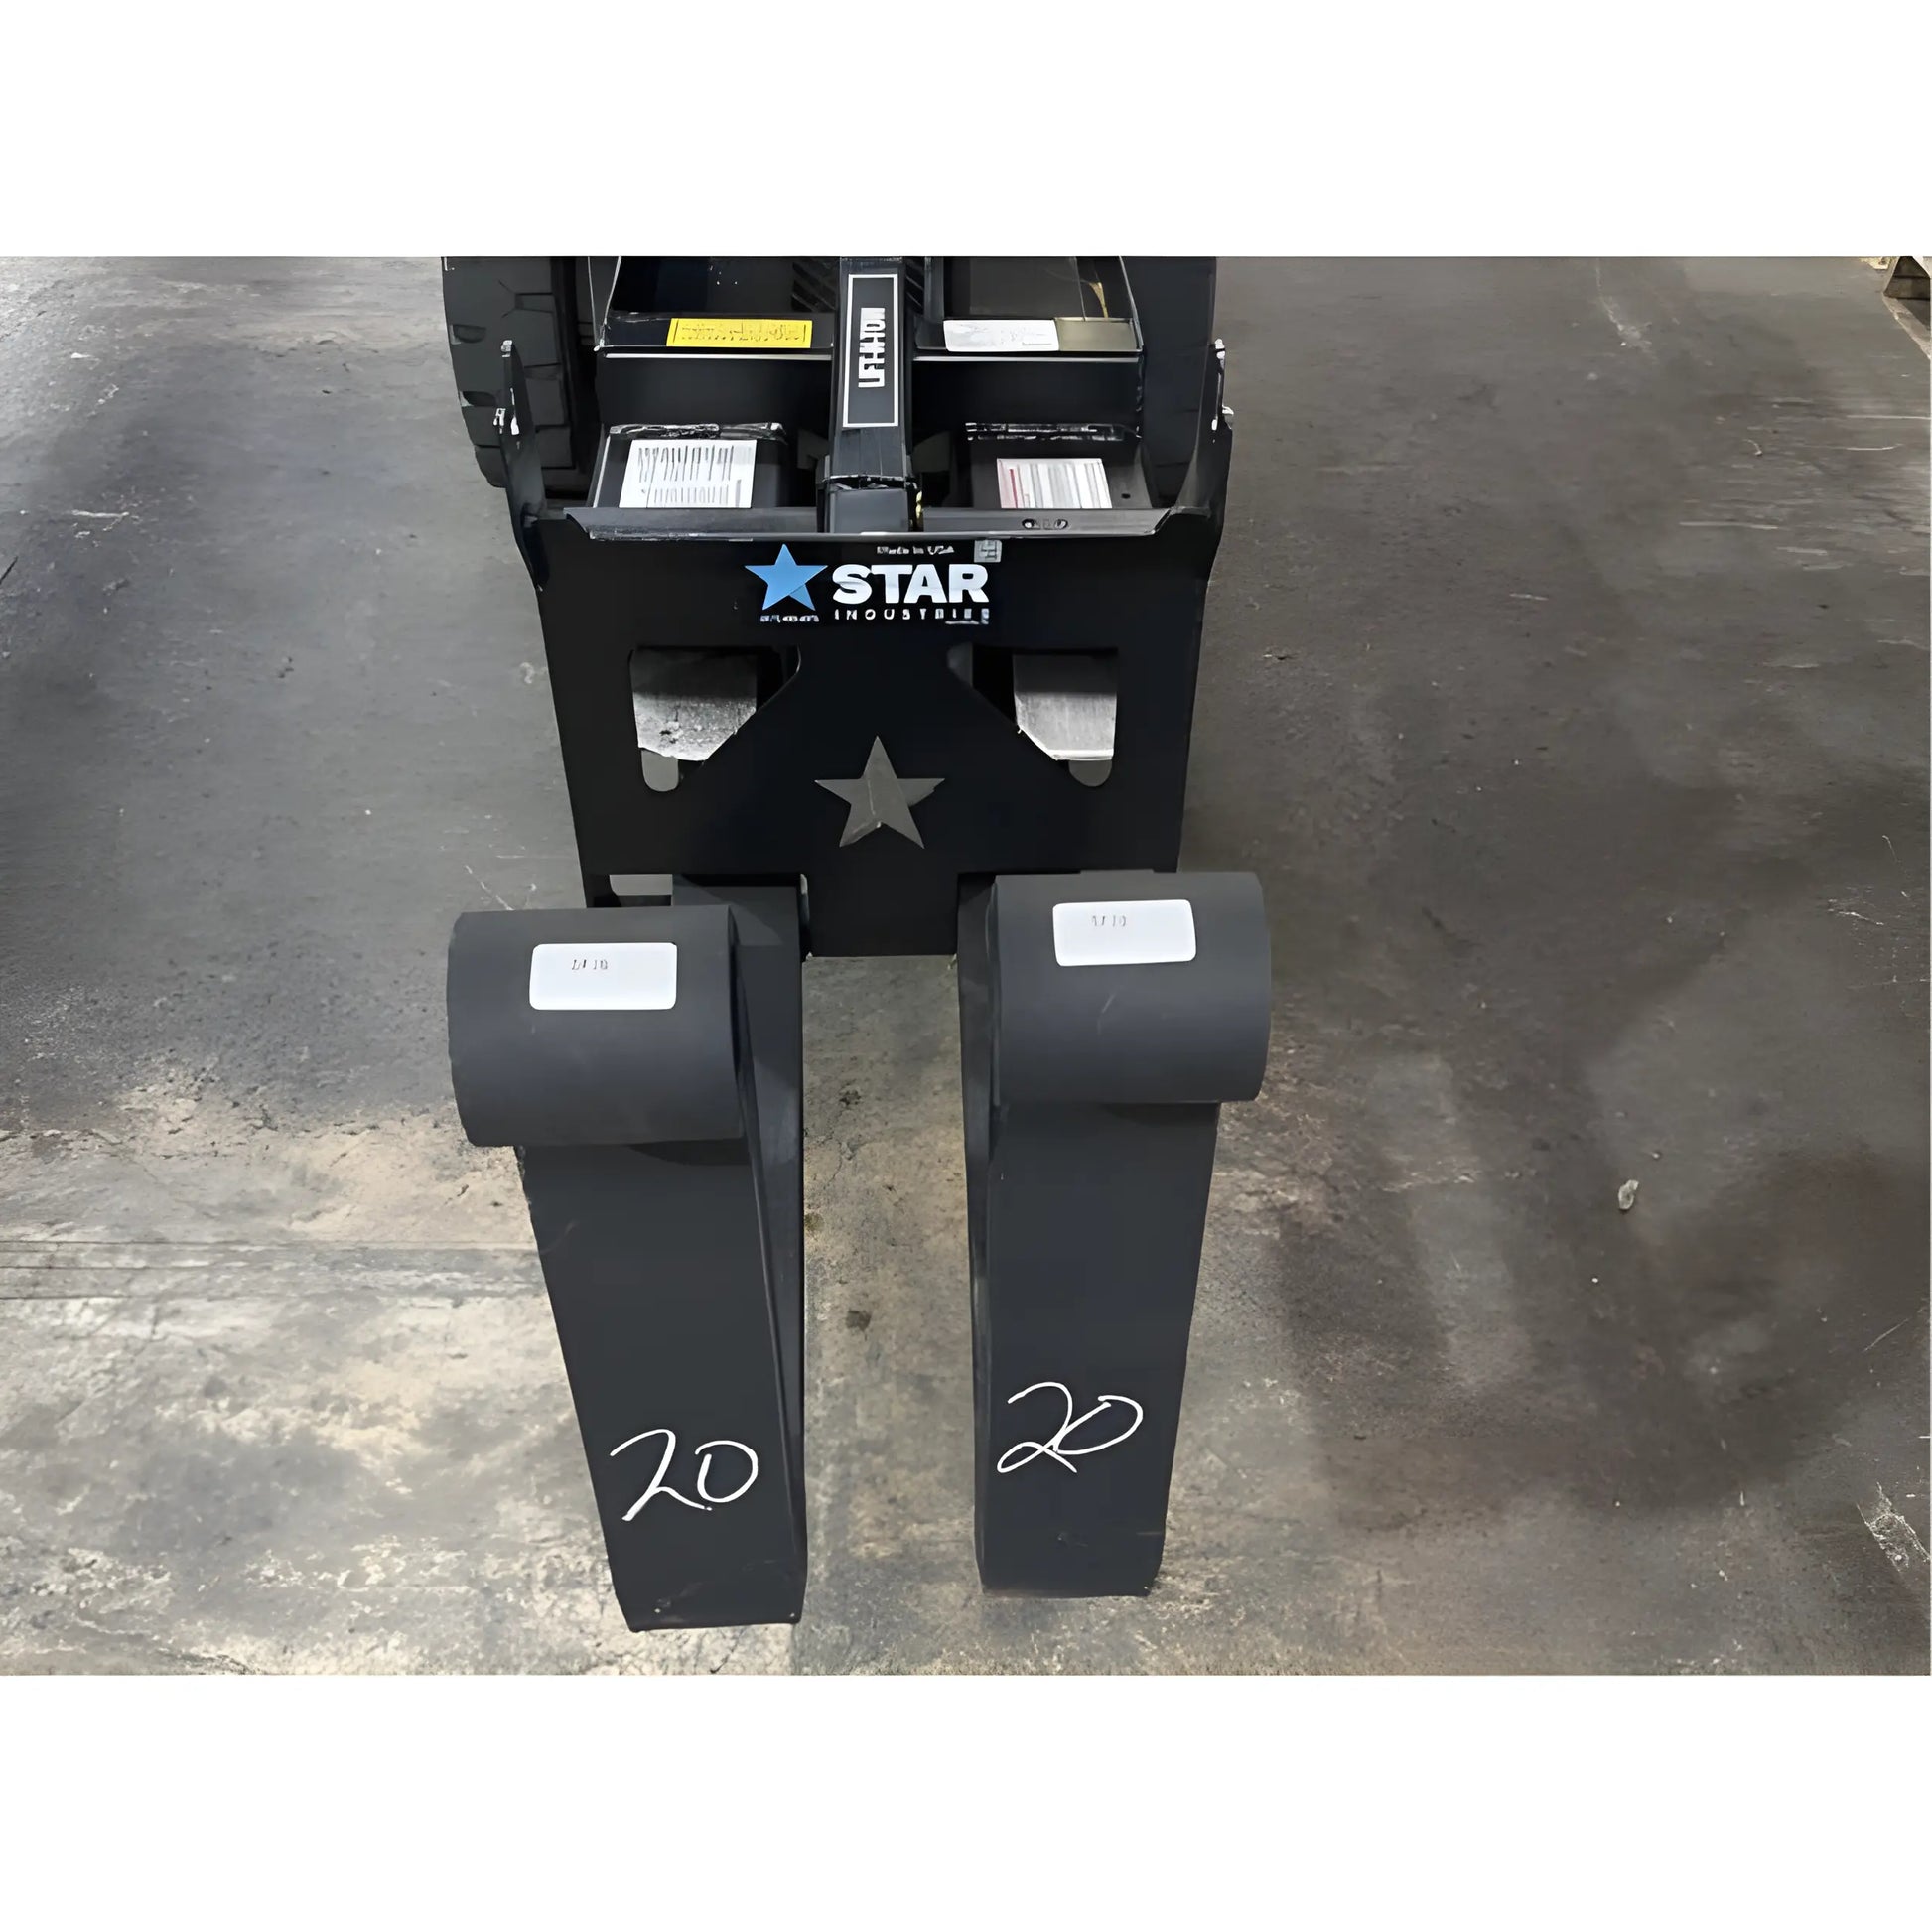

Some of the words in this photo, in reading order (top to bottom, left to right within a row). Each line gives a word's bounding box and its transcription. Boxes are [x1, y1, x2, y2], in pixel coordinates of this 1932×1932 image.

[832, 563, 990, 605] STAR
[996, 1381, 1144, 1474] 20
[609, 1428, 759, 1522] 20
